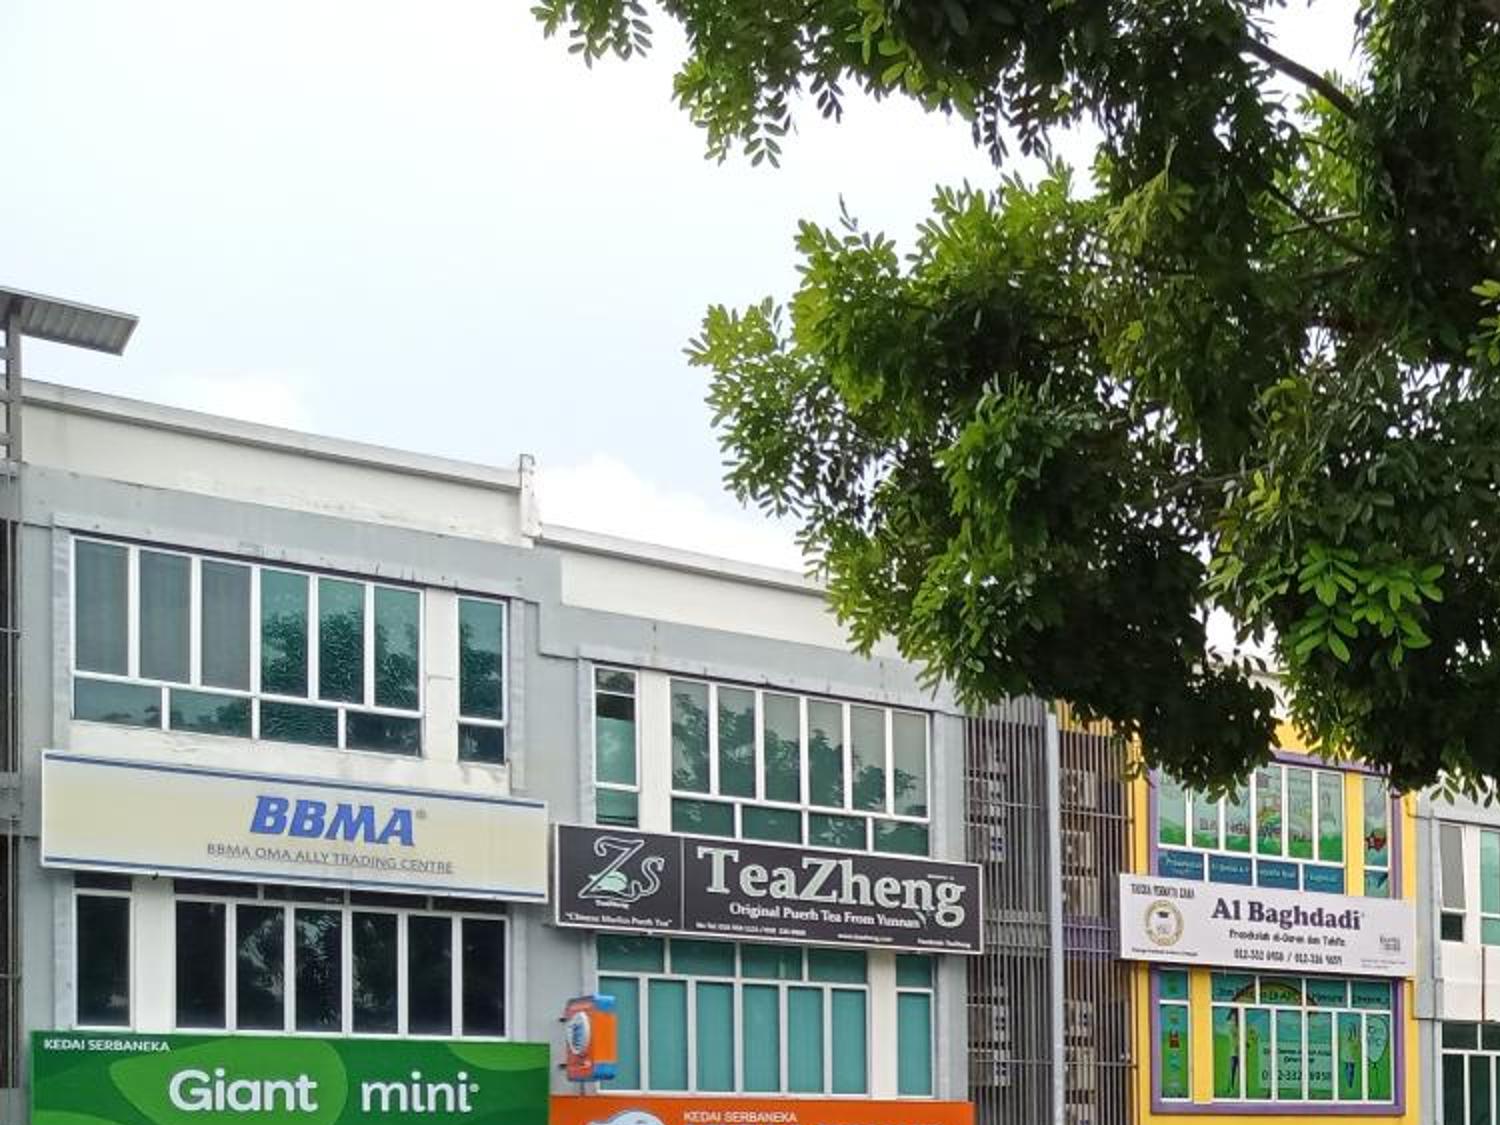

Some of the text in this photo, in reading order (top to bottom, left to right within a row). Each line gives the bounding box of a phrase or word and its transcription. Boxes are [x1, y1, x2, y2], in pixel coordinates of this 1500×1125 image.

[207, 843, 455, 874] BBMA OMA ALLY TRADING CENTRE
[697, 846, 966, 928] TeaZheng
[729, 902, 920, 929] Original Puerh Tea From Yunnan
[1210, 898, 1361, 931] Al Baghdadi
[44, 1039, 170, 1052] KEDAI SERBANEKA
[169, 1069, 471, 1113] Giant mini
[684, 1111, 797, 1123] KEDAI SERBANEKA
